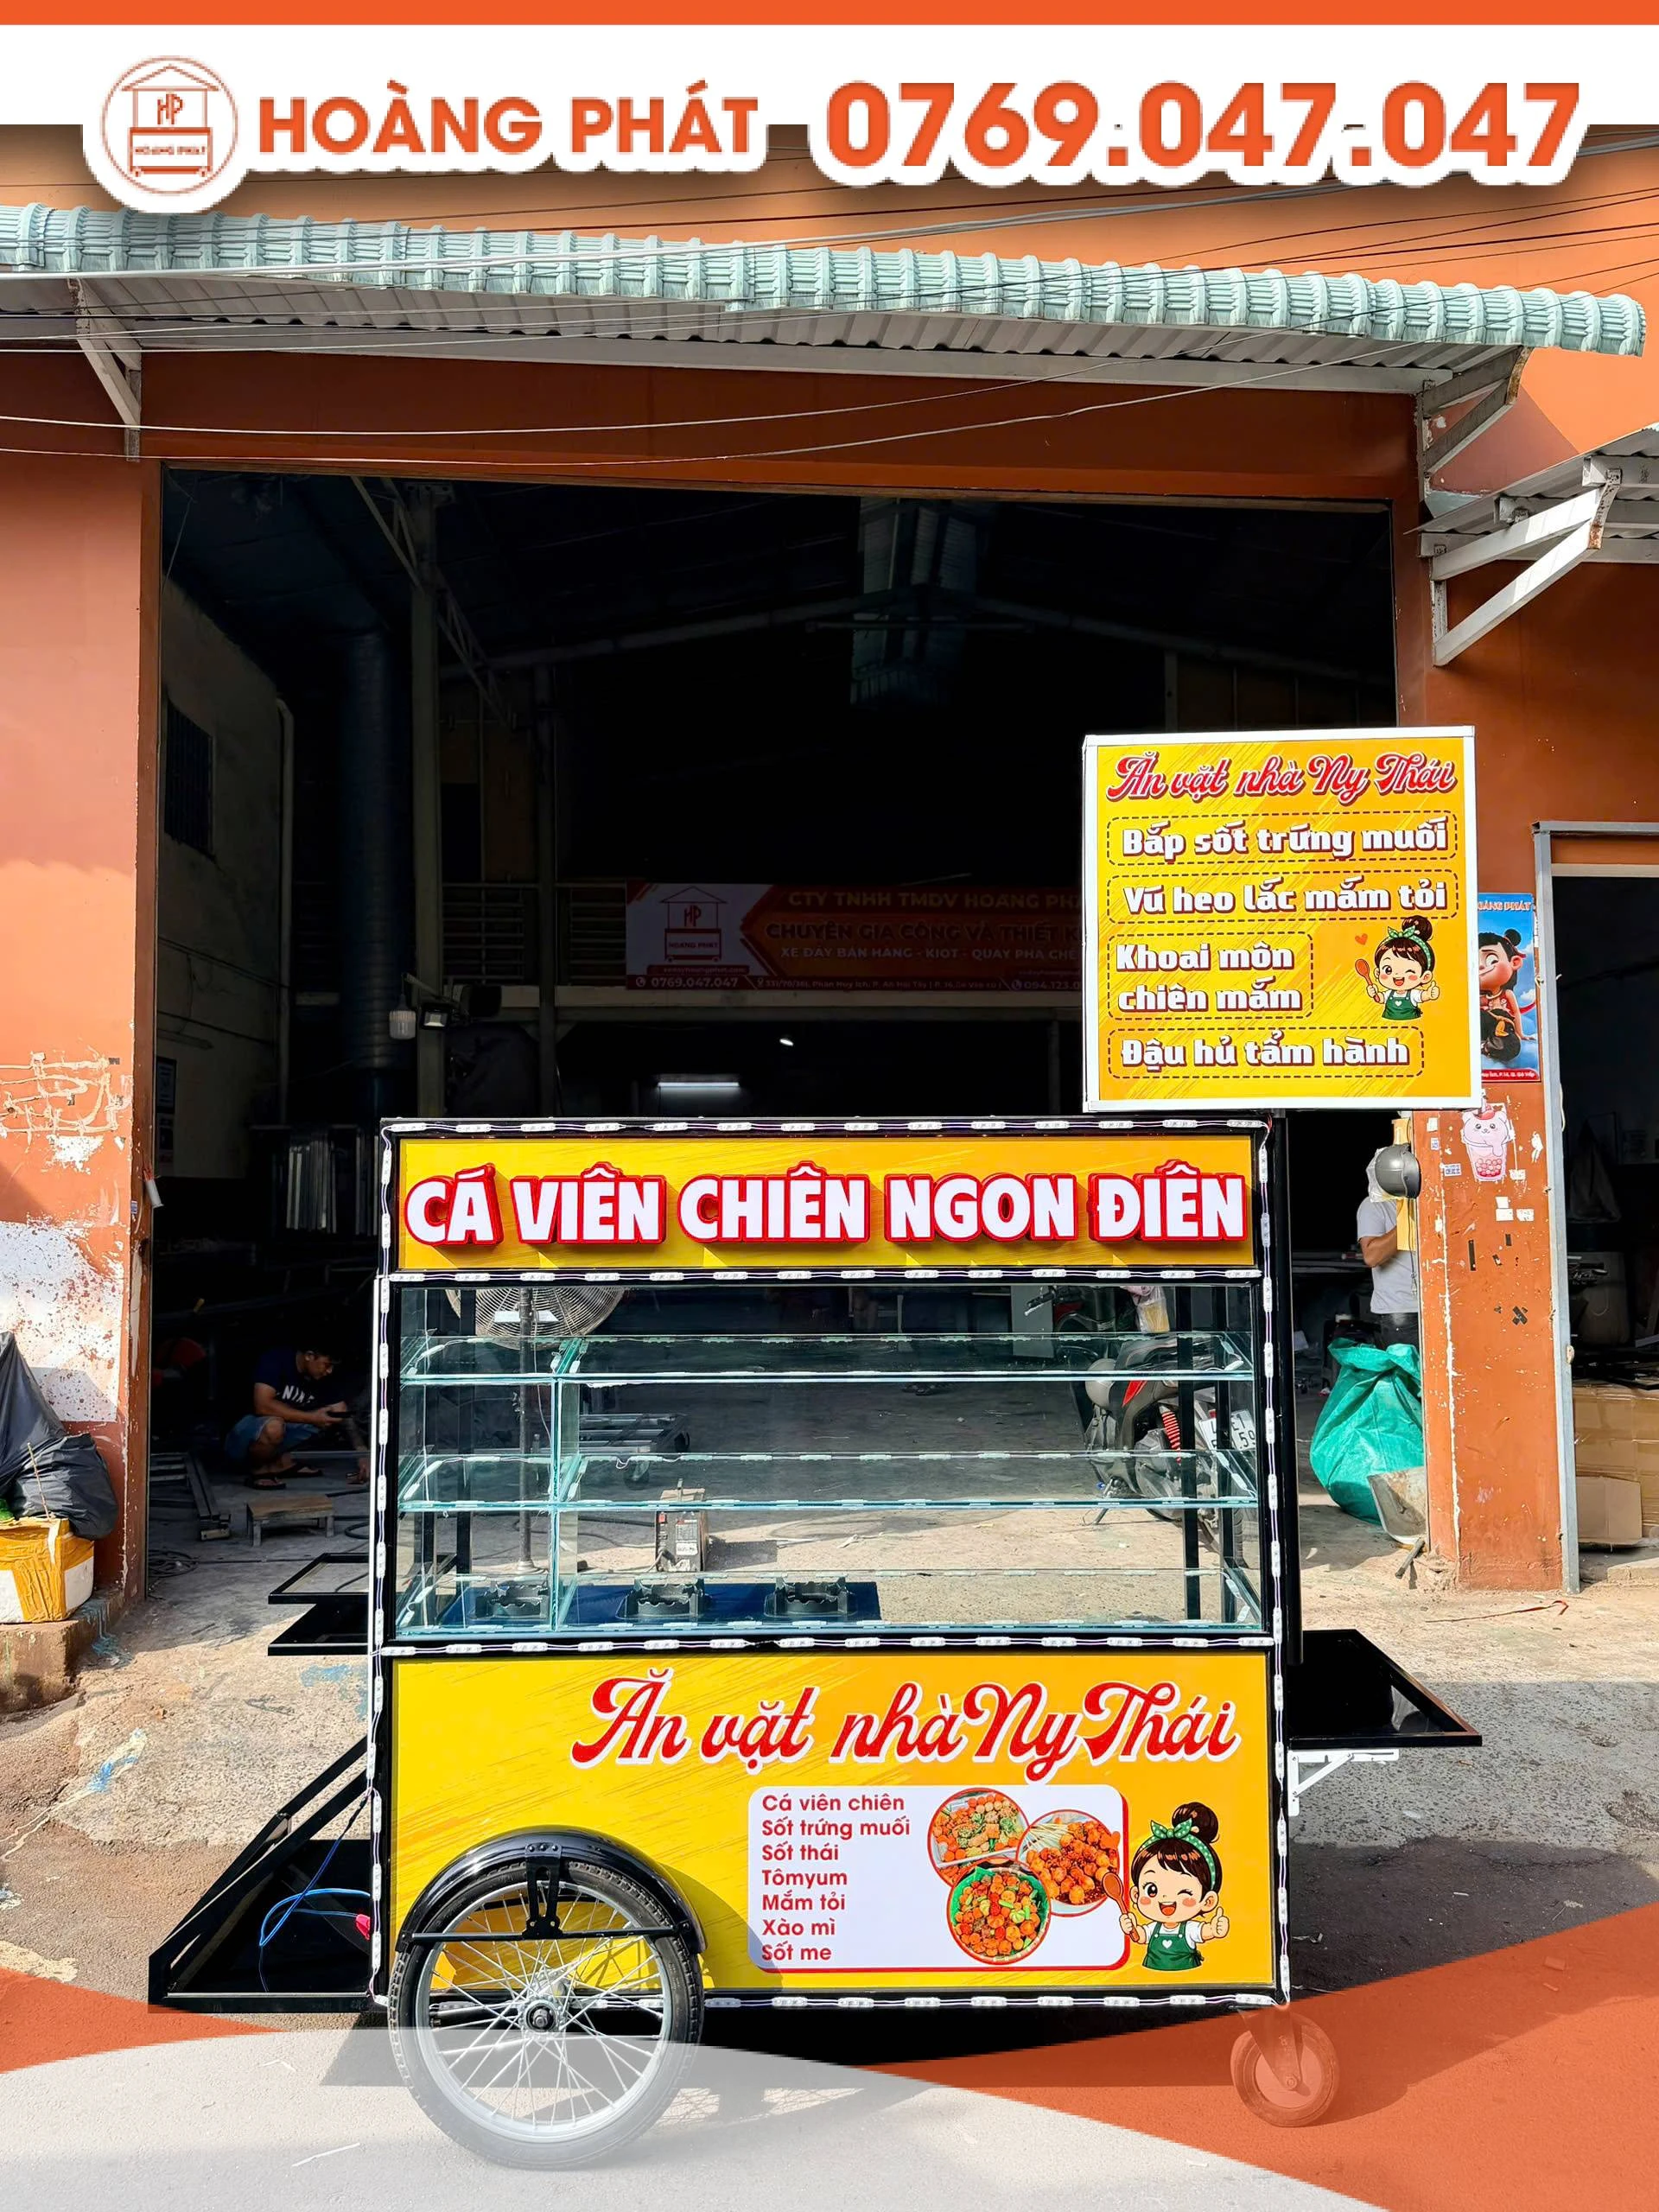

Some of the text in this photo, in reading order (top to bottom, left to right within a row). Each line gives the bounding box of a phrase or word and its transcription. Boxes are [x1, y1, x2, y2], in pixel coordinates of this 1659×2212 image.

[1107, 751, 1457, 805] Ăn vặt nhà Ny Thái
[1122, 817, 1448, 862] Bắp sốt trứng muối
[788, 892, 828, 906] CTY
[833, 892, 891, 906] TNHH
[898, 892, 958, 907] TMDV
[1173, 885, 1236, 912] heo
[1243, 878, 1297, 912] lắc
[1305, 875, 1392, 911] mắm
[1399, 878, 1448, 910] tỏi
[766, 920, 852, 940] CHUYÊN
[858, 924, 895, 940] GIA
[899, 919, 960, 940] CÔNG
[1064, 924, 1080, 941] K
[781, 947, 799, 958] XE
[925, 948, 958, 959] KIOT
[1116, 941, 1294, 972] Khoai môn
[651, 976, 739, 988] 0769.047.047
[1118, 976, 1302, 1012] chiên mắm
[1122, 1030, 1409, 1072] Đậu hủ tẩm hành
[404, 1159, 1248, 1246] CÁ VIÊN CHIÊN NGON ĐIÊN
[570, 1669, 1241, 1783] Ăn vặt nhà Ny Thái
[762, 1793, 905, 1811] Cá viên chiên
[762, 1815, 910, 1840] Sốt trứng muối
[762, 1840, 838, 1860] Sốt thái
[762, 1868, 847, 1889] Tômyum
[762, 1890, 845, 1910] Mắm tỏi
[762, 1917, 836, 1936] Xào mì
[762, 1941, 831, 1961] Sốt me
